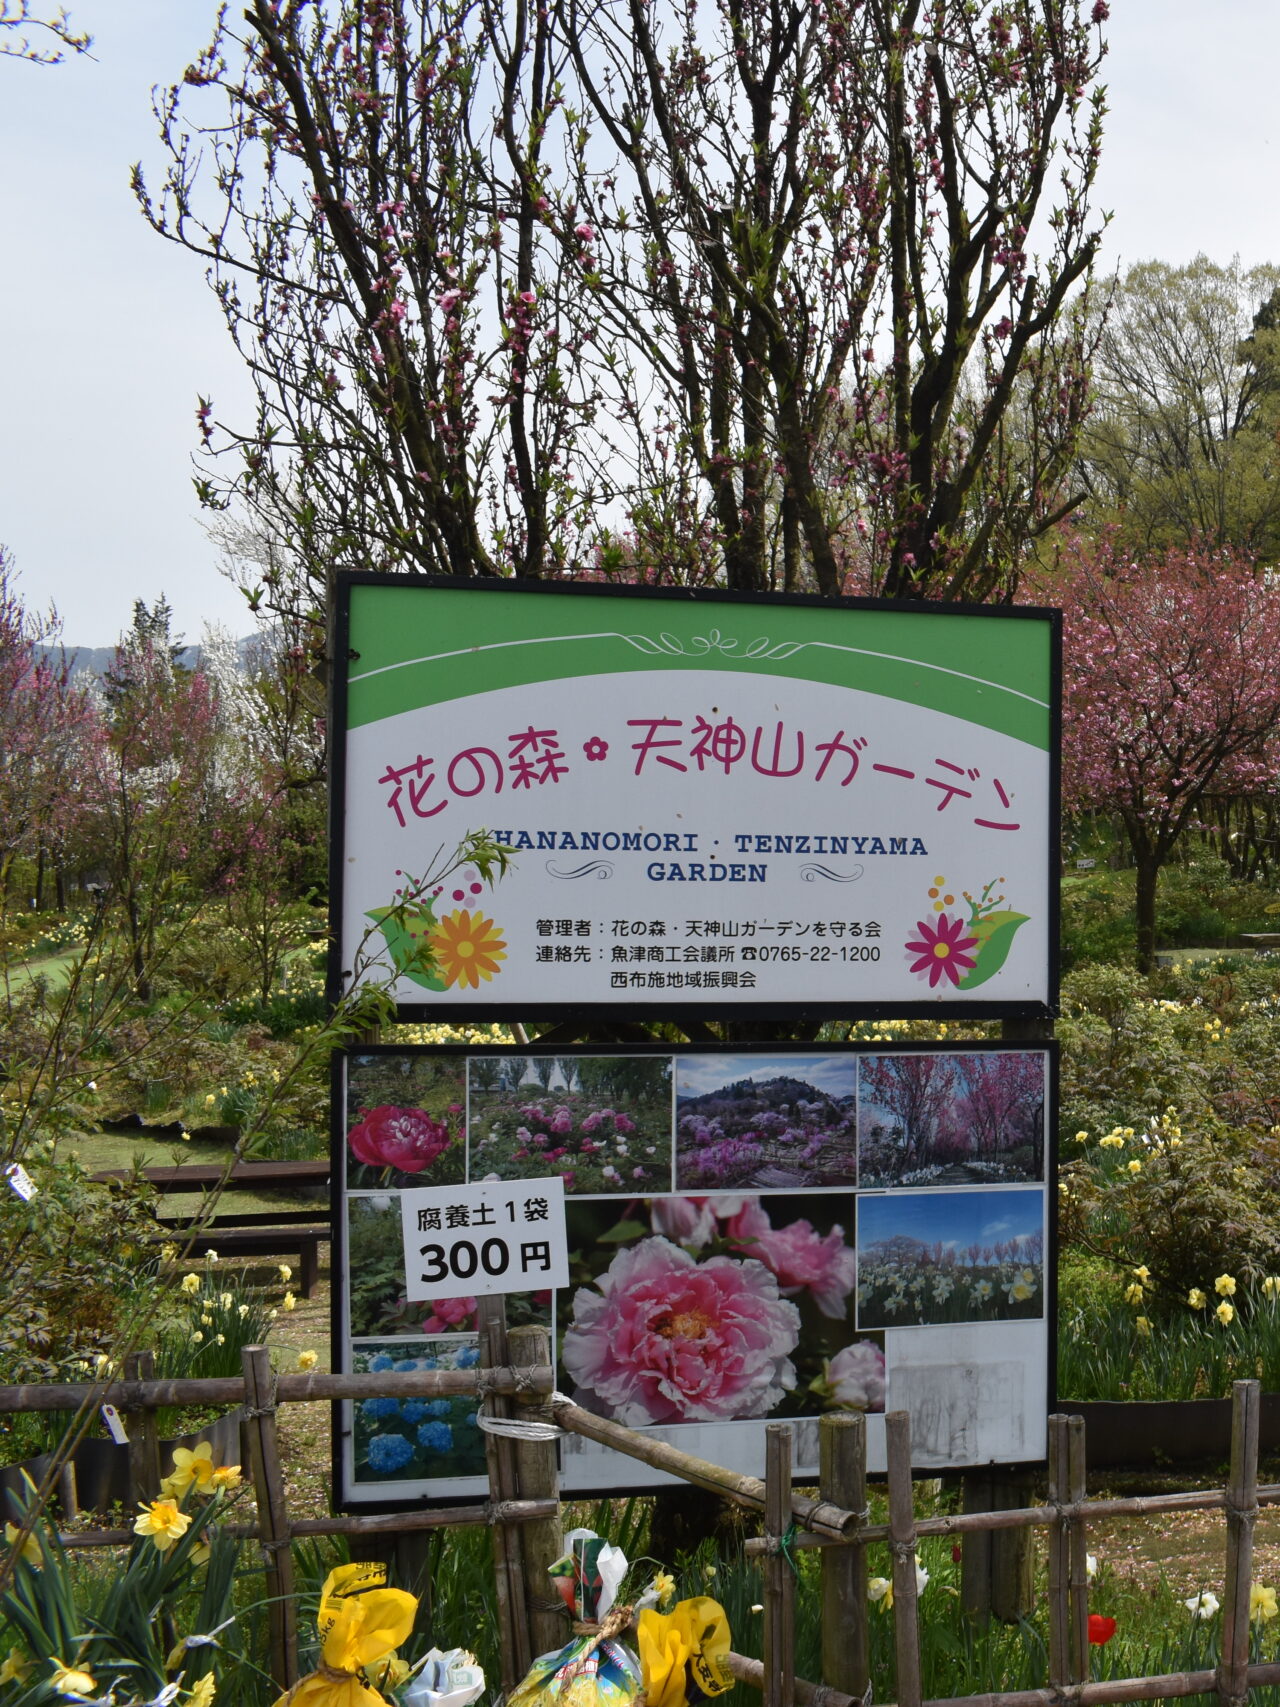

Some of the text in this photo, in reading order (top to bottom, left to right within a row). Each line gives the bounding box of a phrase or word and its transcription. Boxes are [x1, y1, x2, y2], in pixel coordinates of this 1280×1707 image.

[494, 830, 699, 852] HANANOMORI
[734, 834, 929, 856] TENZINYAMA
[646, 862, 768, 883] GARDEN
[610, 971, 757, 989] 西布施地域振興会
[419, 1237, 551, 1283] 300円
